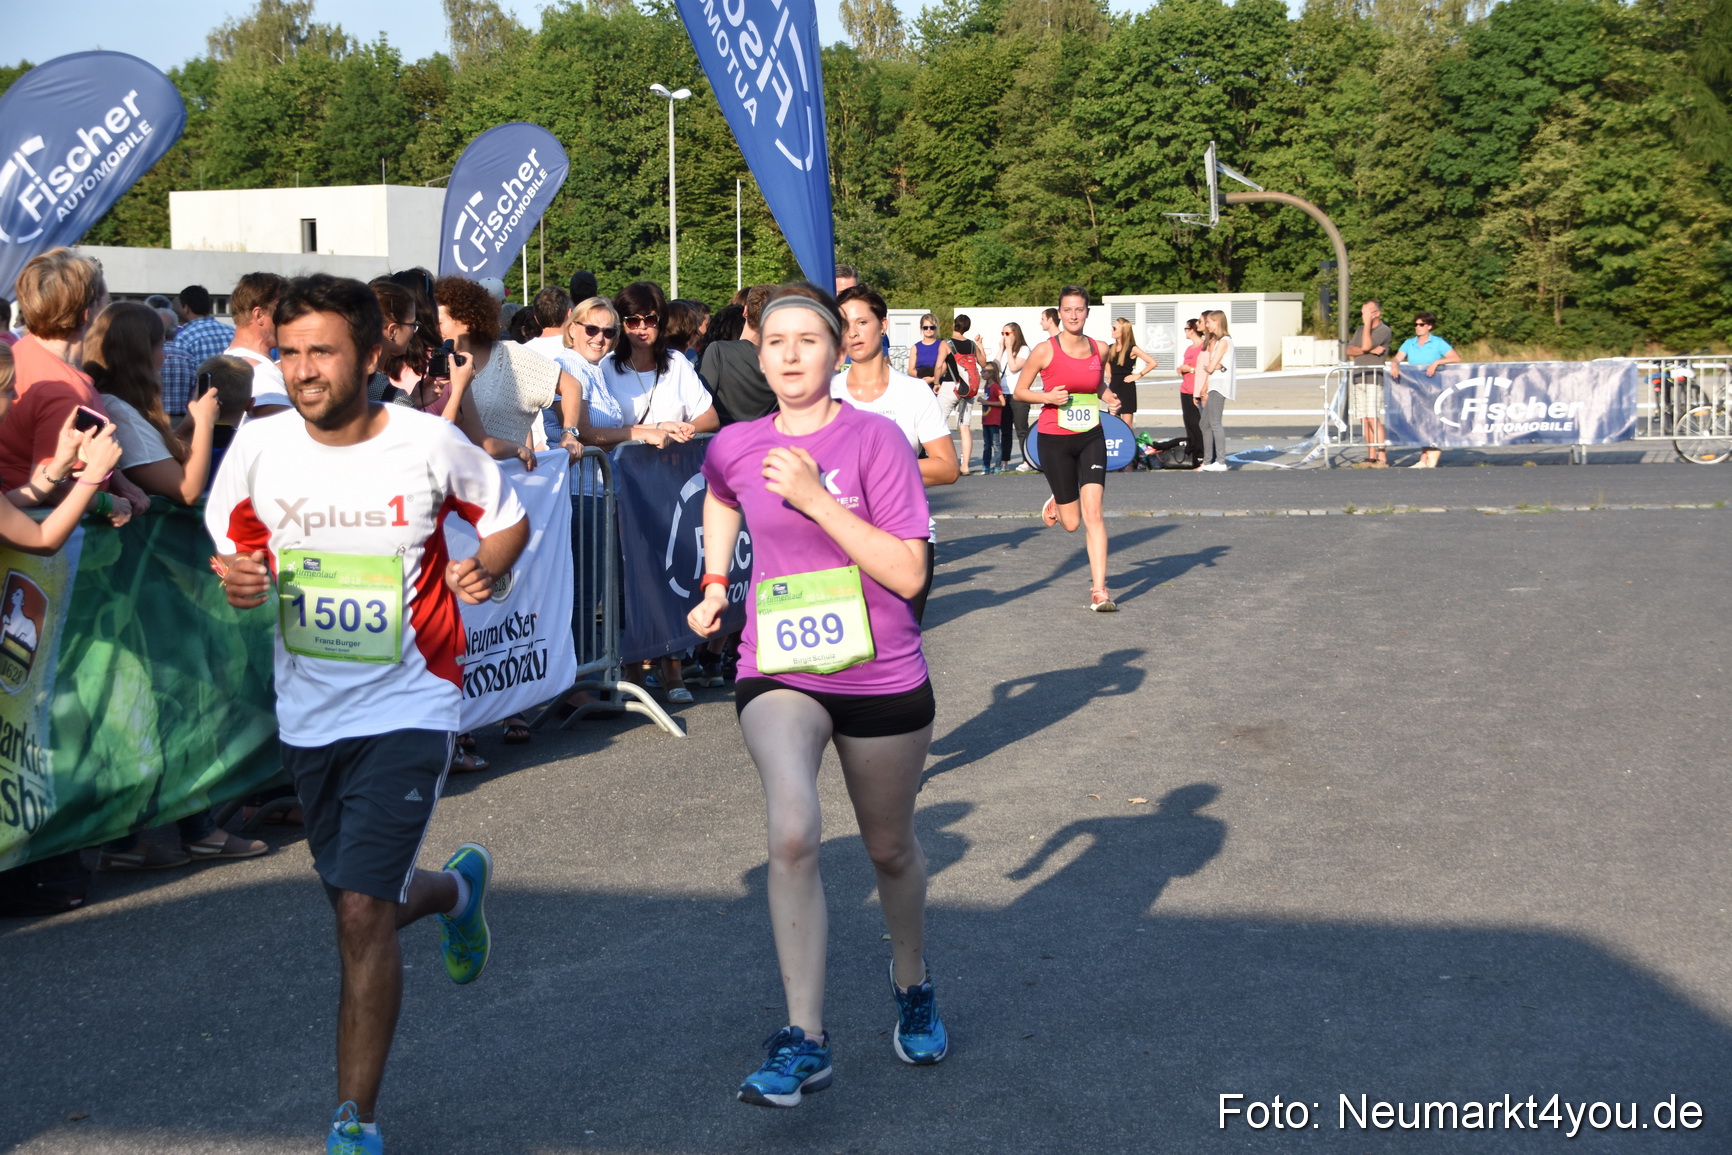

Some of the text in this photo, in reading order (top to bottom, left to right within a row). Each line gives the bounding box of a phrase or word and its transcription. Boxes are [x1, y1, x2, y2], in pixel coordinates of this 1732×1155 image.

[17, 89, 141, 223] Fischer
[56, 119, 153, 223] AUTOMOBILE
[469, 148, 540, 254] Fischer
[494, 168, 548, 253] AUTOMOBILE
[1066, 408, 1091, 422] 908
[1460, 396, 1584, 421] Fischer
[1471, 421, 1573, 434] AUTOMOBILE
[295, 568, 337, 579] firmenlauf
[291, 593, 389, 634] 1503
[314, 636, 361, 649] Franz Burger
[776, 612, 844, 651] 689
[812, 653, 836, 662] Schulz
